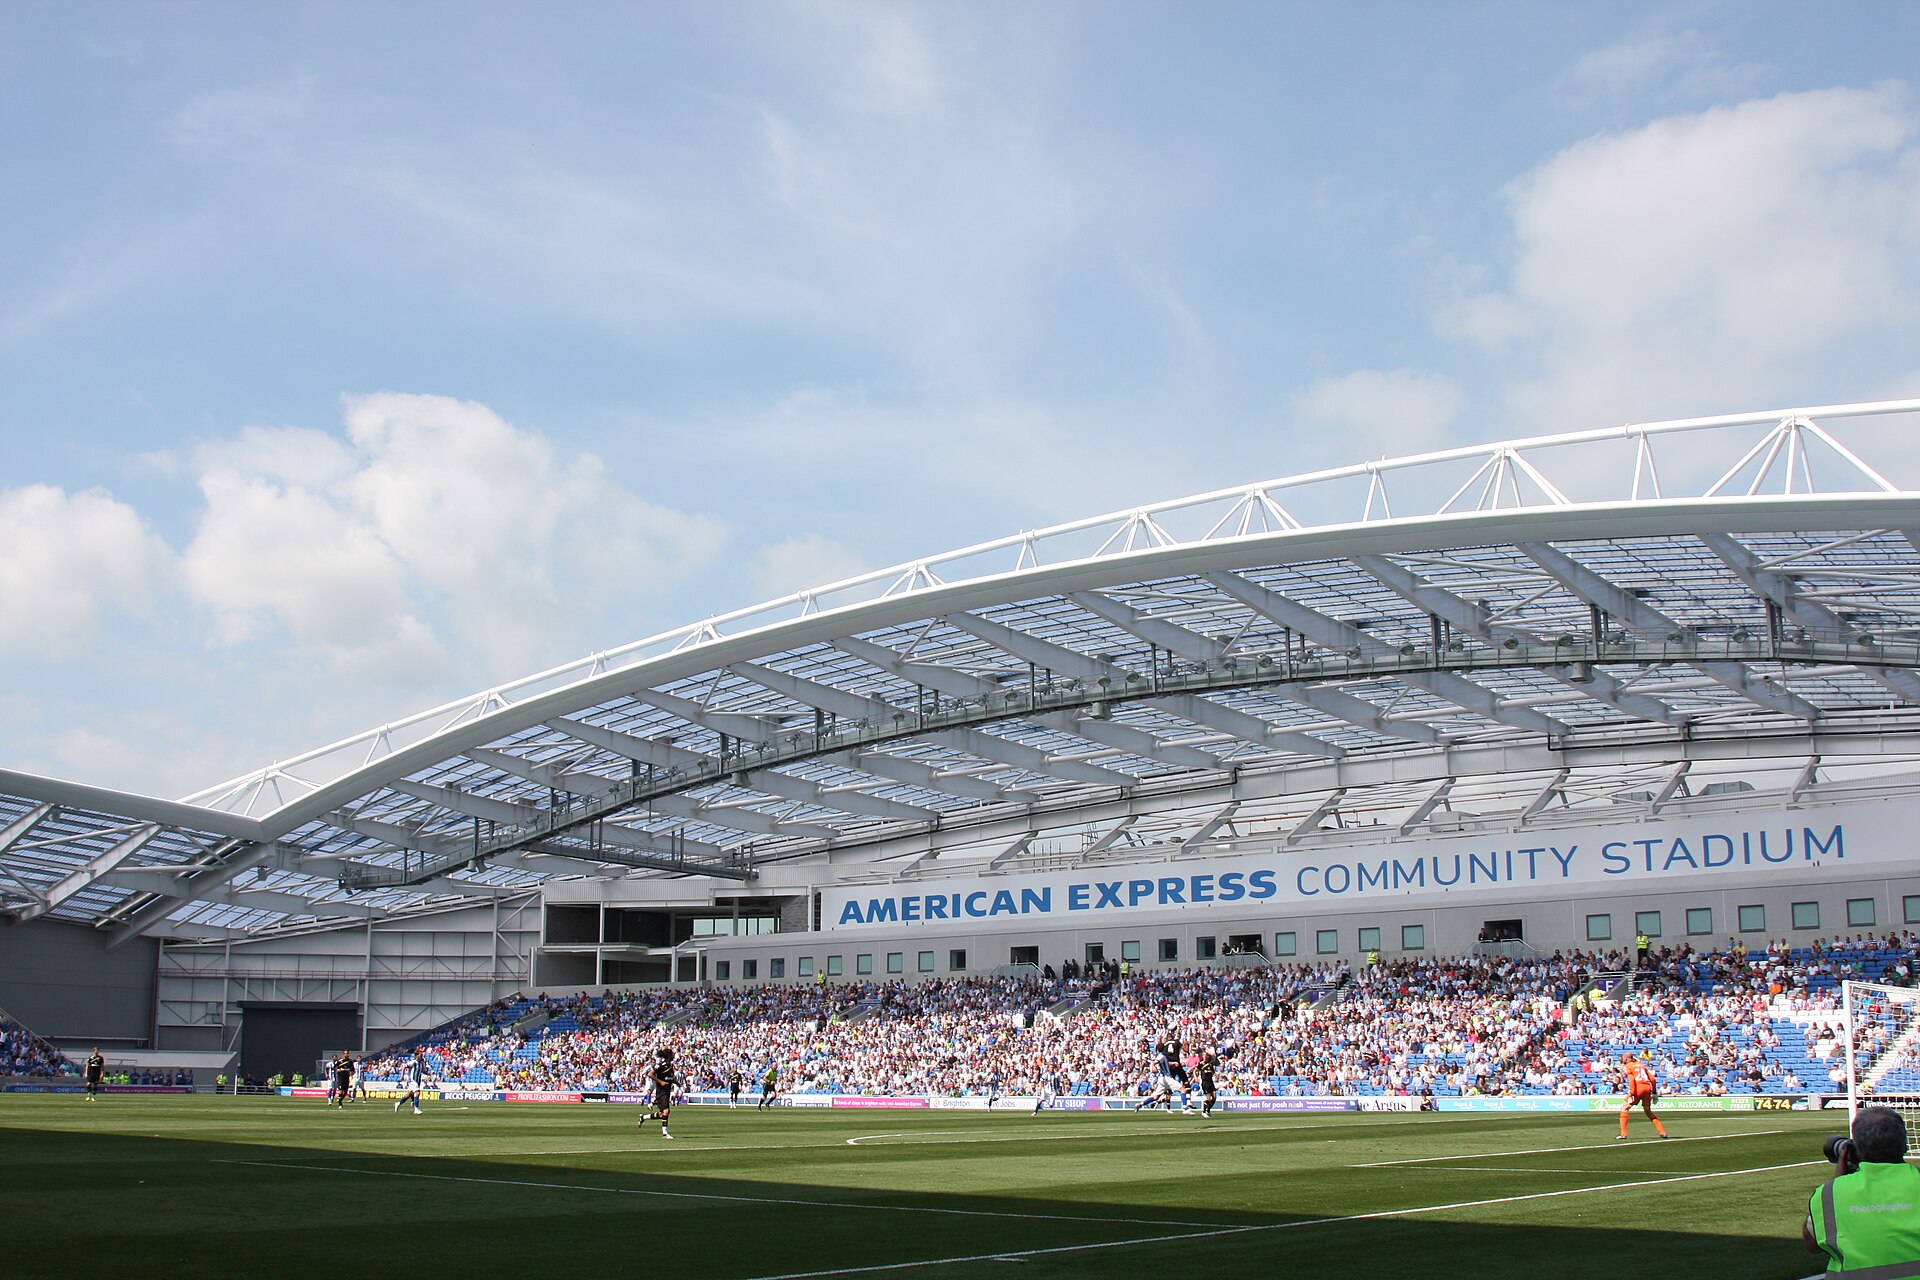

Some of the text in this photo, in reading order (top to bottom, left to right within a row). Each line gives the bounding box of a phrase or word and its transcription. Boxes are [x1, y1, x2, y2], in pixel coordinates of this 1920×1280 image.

[838, 824, 1845, 925] AMERICAN EXPRESS COMMUNITY STADIUM
[444, 1092, 464, 1100] BECKS
[464, 1092, 494, 1101] PEUGEOT
[1065, 1099, 1086, 1108] SHOP
[1249, 1101, 1260, 1110] just
[1272, 1101, 1287, 1109] posh
[1372, 1099, 1407, 1112] Argus
[1678, 1100, 1723, 1109] RISTORANTE
[1849, 1203, 1913, 1214] Photographer
